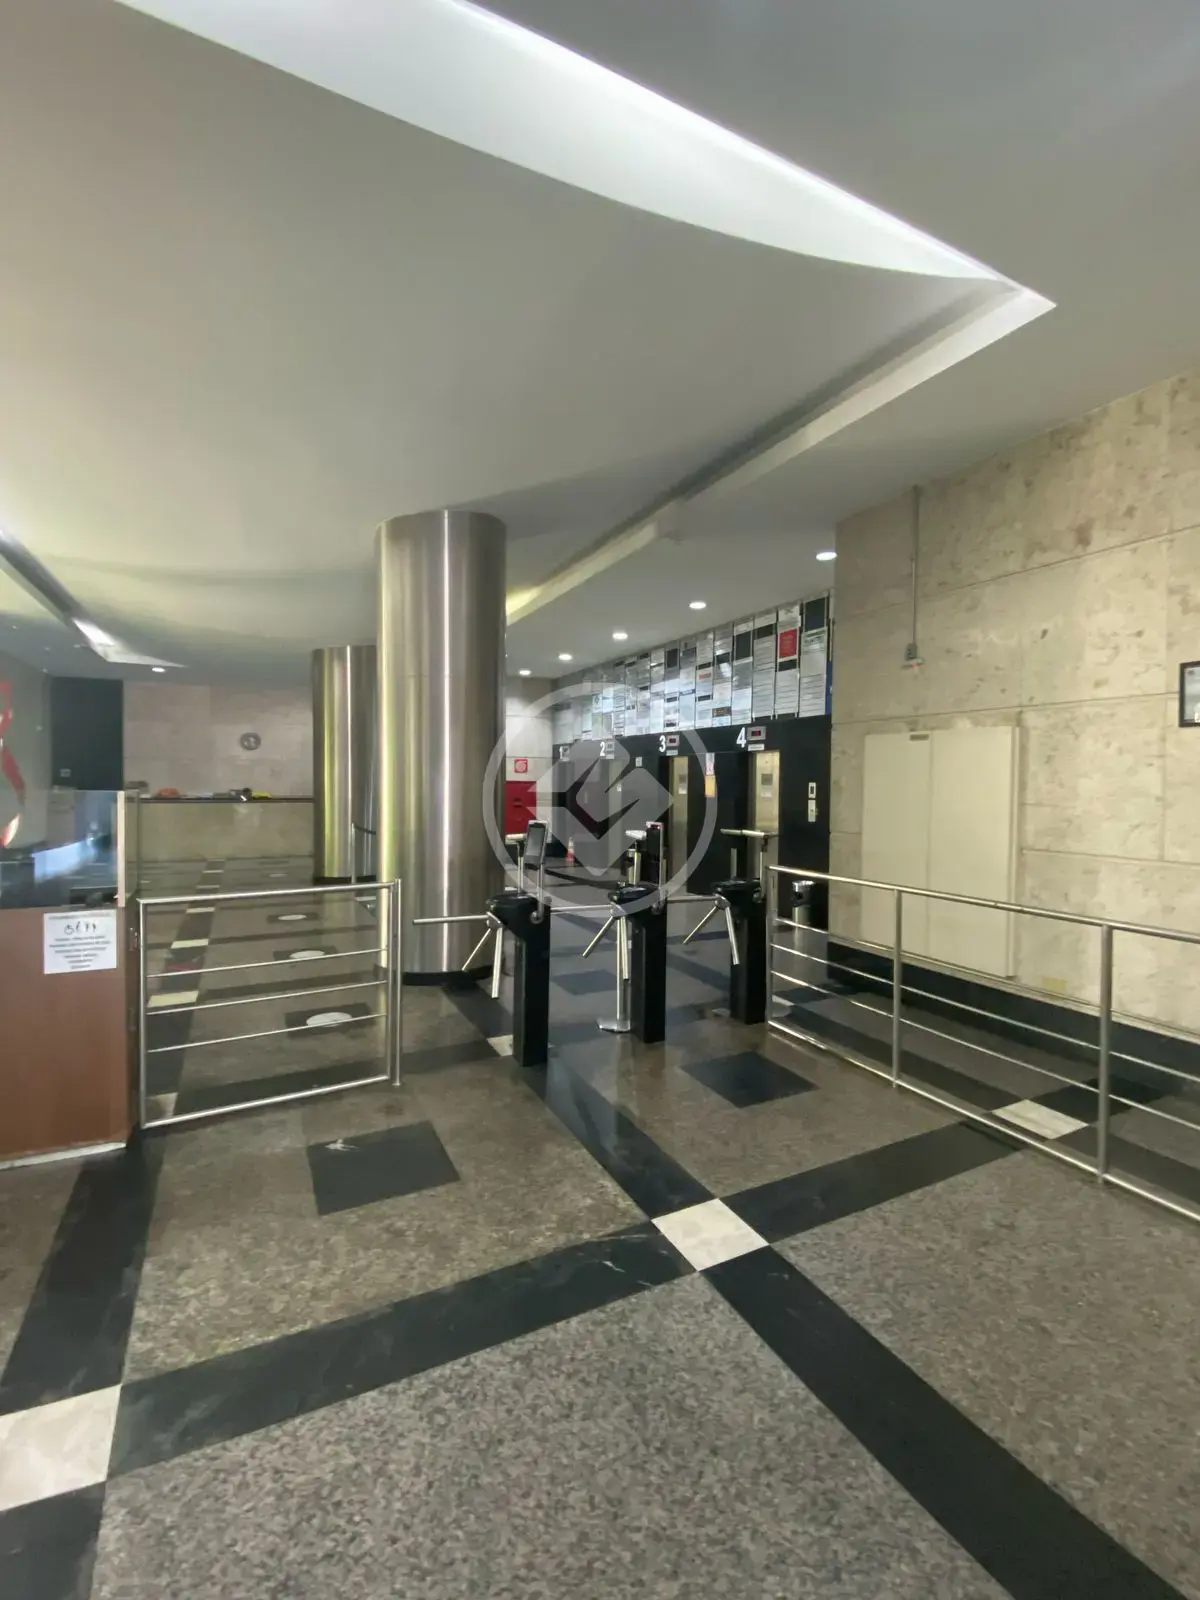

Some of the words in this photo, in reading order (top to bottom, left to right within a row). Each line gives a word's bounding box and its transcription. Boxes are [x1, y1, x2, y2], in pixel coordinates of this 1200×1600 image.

[659, 735, 666, 752] 3
[736, 727, 747, 748] 4
[600, 742, 606, 756] 2
